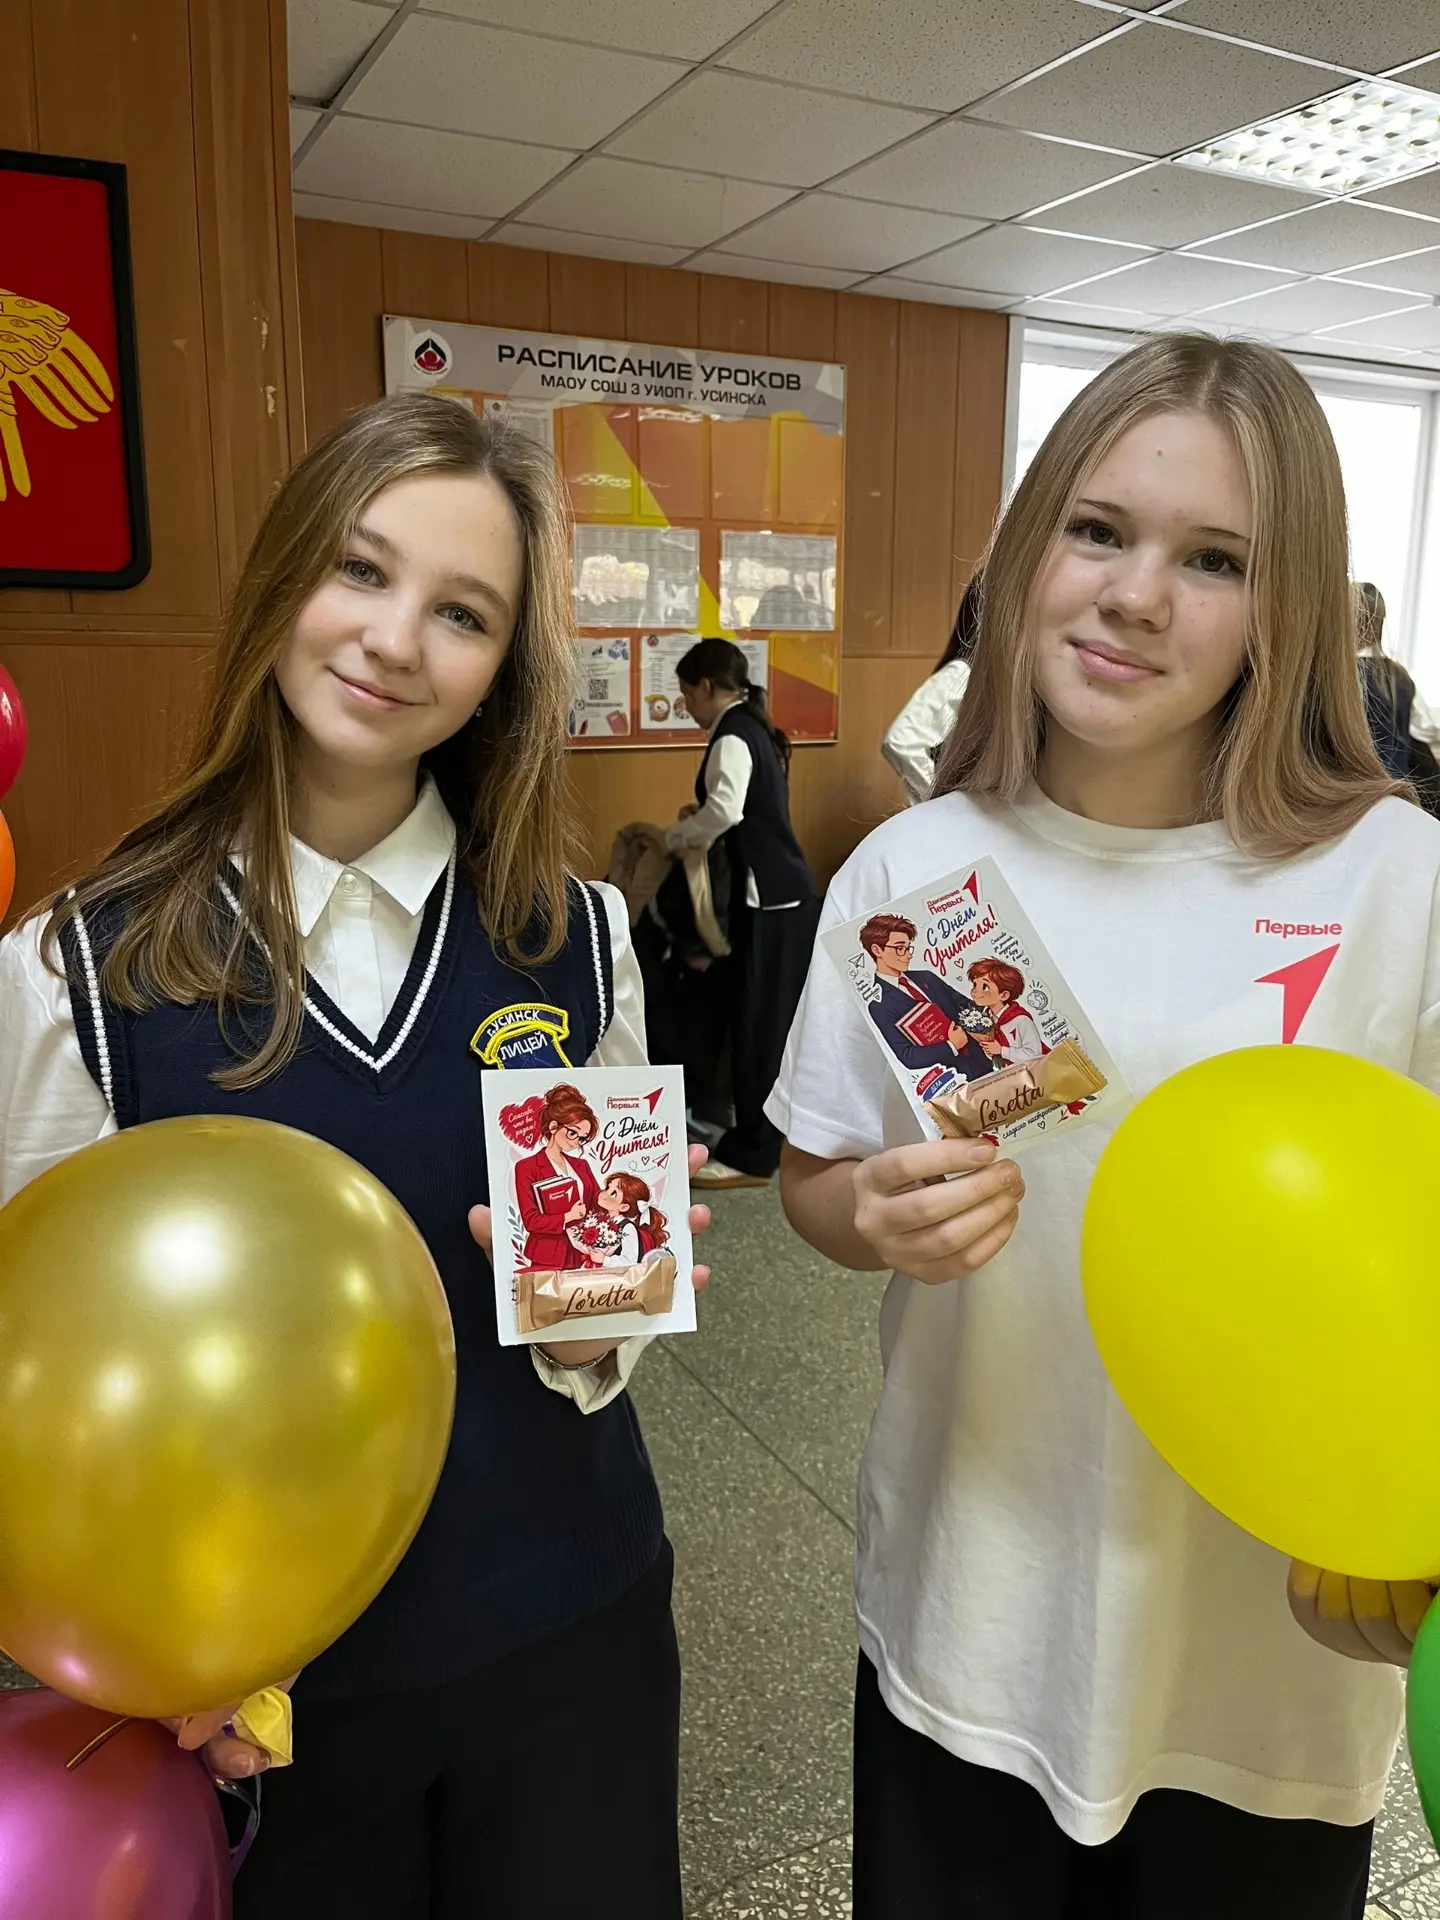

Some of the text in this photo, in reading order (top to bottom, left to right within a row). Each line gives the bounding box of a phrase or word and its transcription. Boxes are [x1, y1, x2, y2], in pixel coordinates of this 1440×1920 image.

[498, 345, 801, 391] РАСПИСАНИЕ УРОКОВ
[541, 374, 767, 407] МАОУ СОШ 3 УИОП г. УСИНСКА
[929, 896, 965, 915] Первых
[937, 907, 976, 939] Днём
[1255, 919, 1343, 939] Первые
[923, 904, 998, 977] Учителя!
[491, 1010, 540, 1031] УСИНСК
[500, 1031, 548, 1060] ЛИЦЕЙ
[607, 1101, 640, 1110] Первых
[980, 1084, 1045, 1130] Loretta
[617, 1116, 659, 1138] Днём
[595, 1125, 669, 1174] Учителя!
[563, 1284, 638, 1317] Loretta
